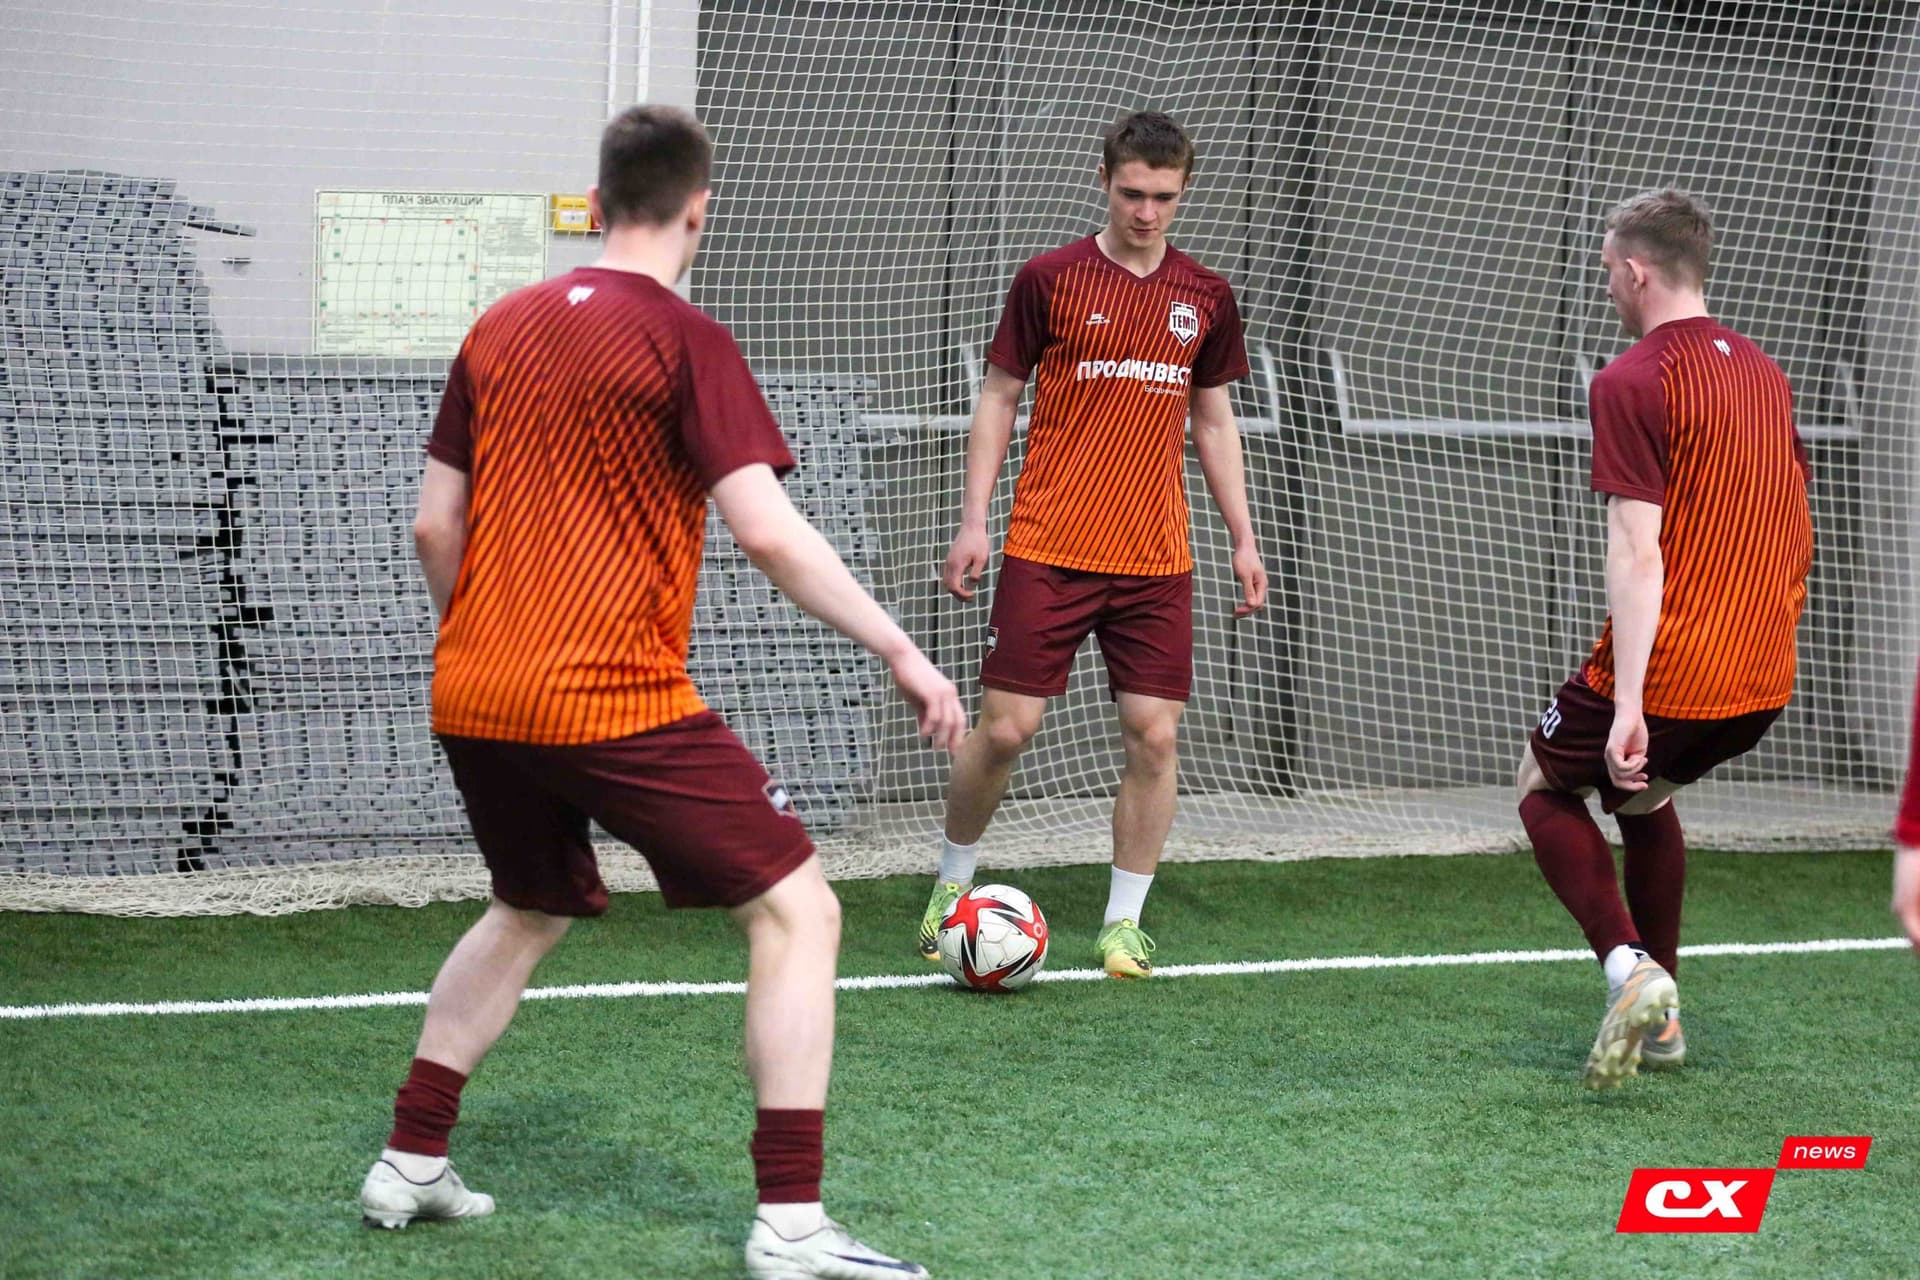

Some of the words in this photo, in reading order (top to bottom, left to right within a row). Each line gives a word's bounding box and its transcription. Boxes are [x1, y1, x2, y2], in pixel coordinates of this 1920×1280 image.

[382, 195, 414, 205] ПЛАН
[417, 196, 483, 206] ЭВАКУАЦИИ
[1172, 314, 1197, 333] ТЕМП
